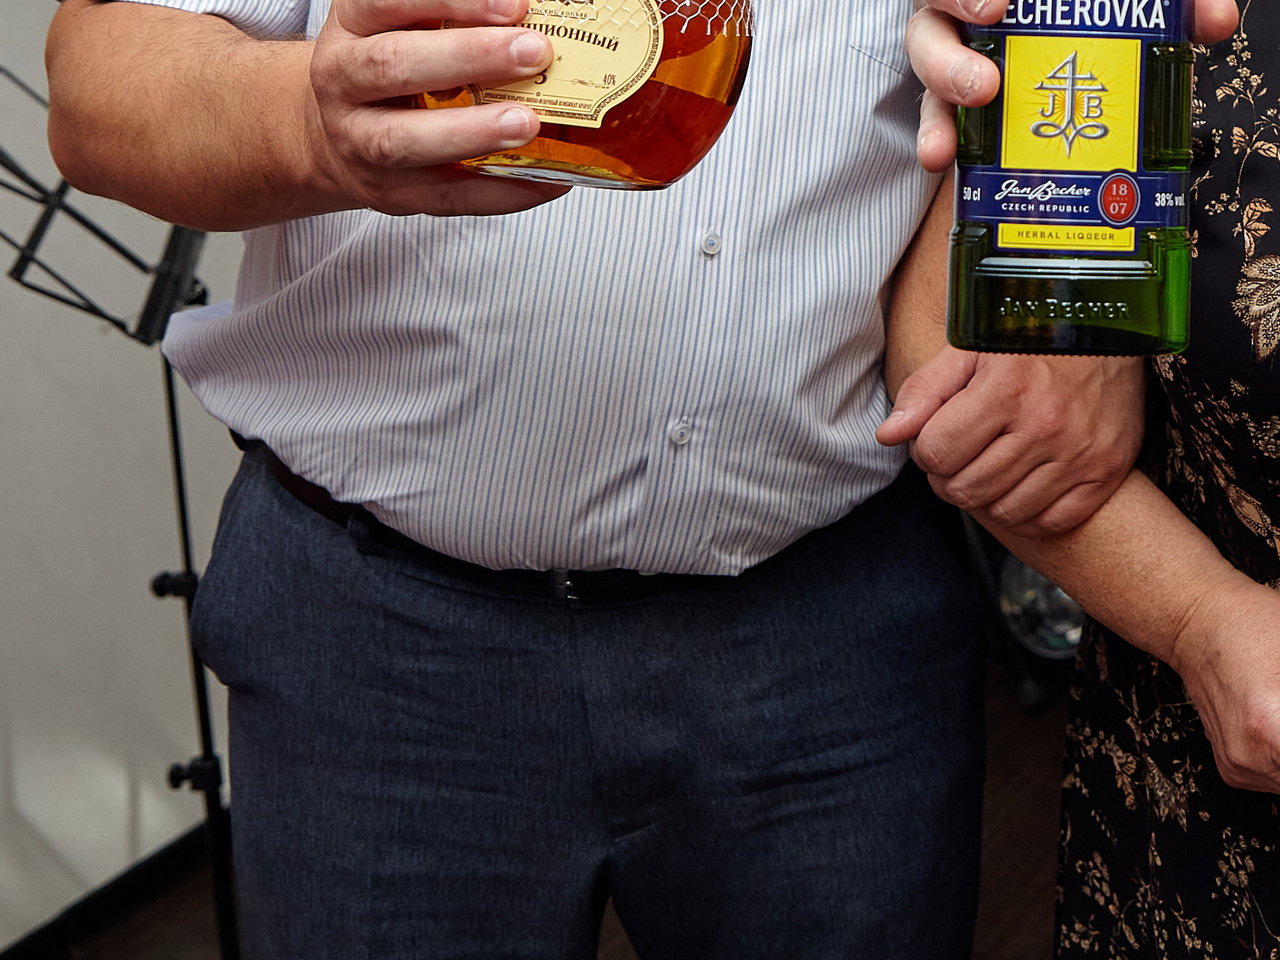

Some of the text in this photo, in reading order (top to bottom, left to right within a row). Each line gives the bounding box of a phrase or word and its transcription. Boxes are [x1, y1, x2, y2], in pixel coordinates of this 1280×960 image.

[521, 23, 619, 52] ЦИОННЫЙ
[603, 74, 616, 86] 40%
[1038, 93, 1056, 118] J
[1083, 94, 1103, 119] B
[963, 187, 981, 201] 50 cl
[995, 179, 1091, 201] Jan Becher
[1111, 183, 1128, 196] 18
[1155, 192, 1174, 207] 38%
[1001, 202, 1090, 213] CZECH REPUBLIC
[1109, 202, 1128, 214] 07
[1017, 230, 1115, 240] HERBAL LIQUEUR
